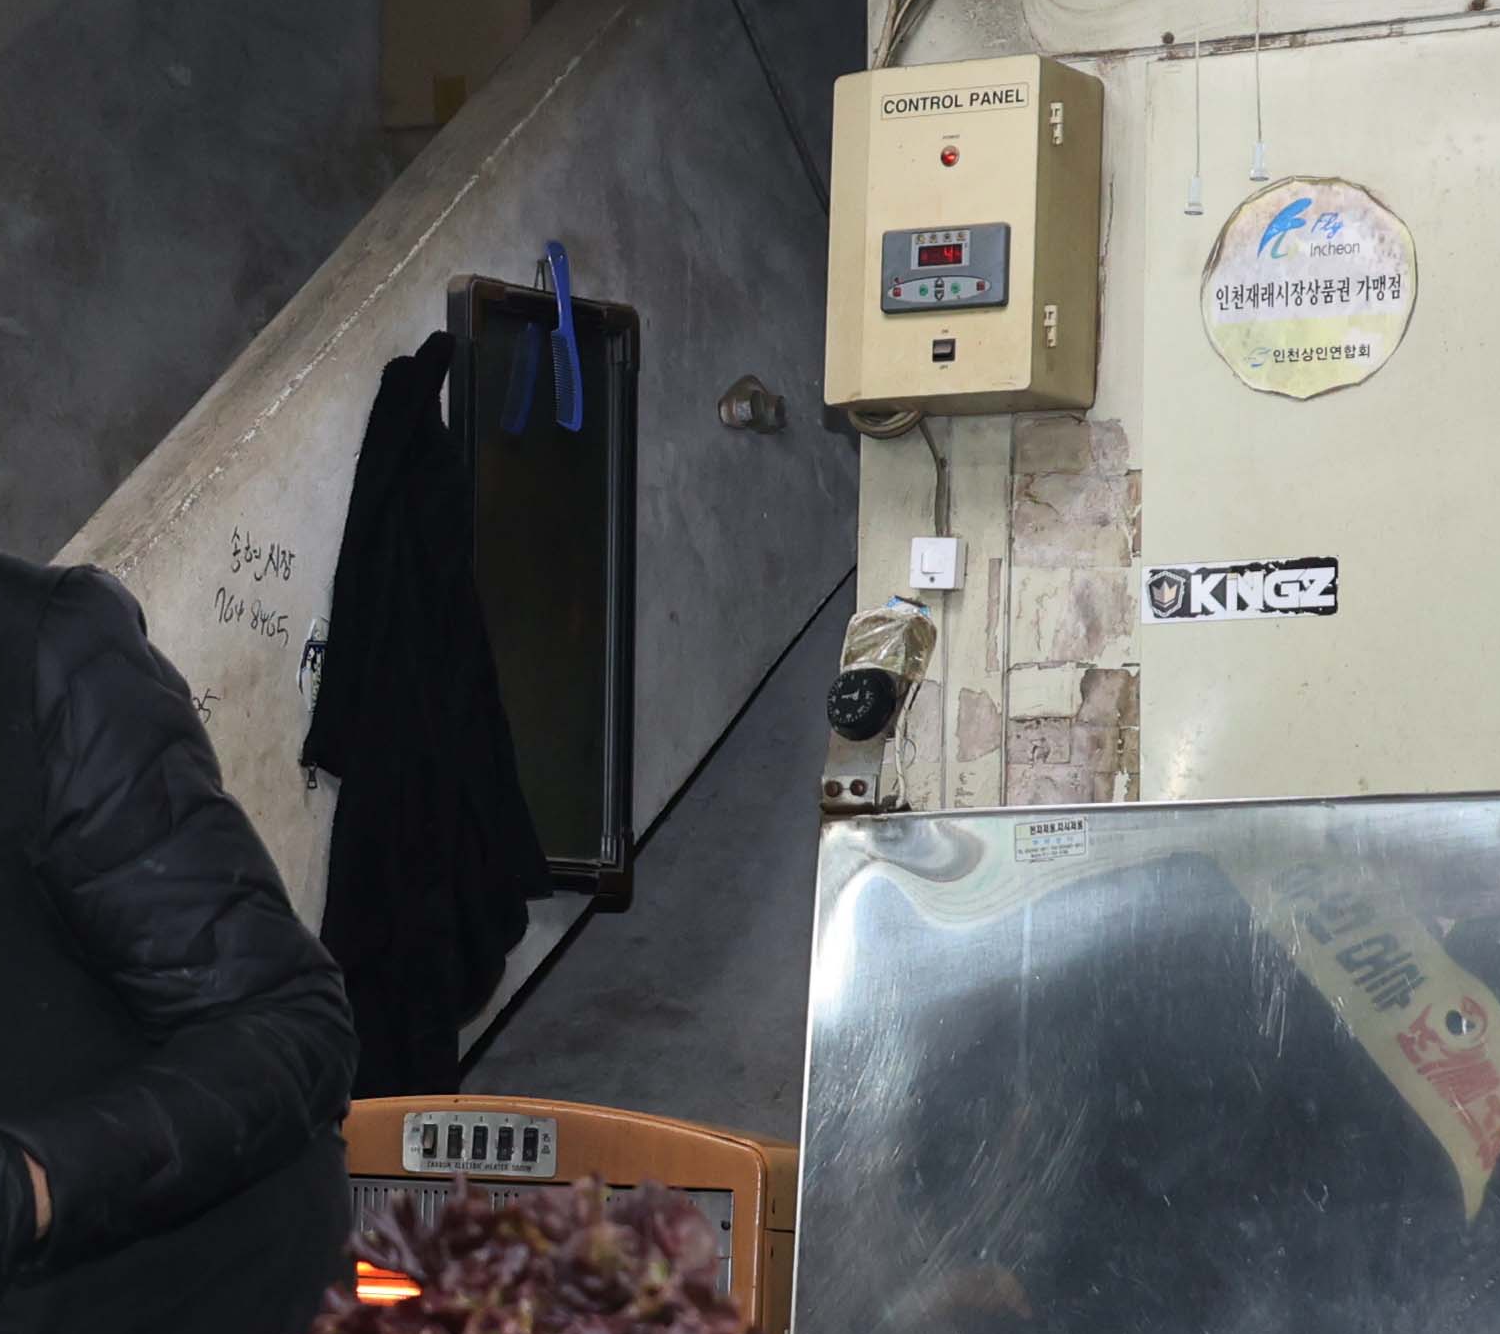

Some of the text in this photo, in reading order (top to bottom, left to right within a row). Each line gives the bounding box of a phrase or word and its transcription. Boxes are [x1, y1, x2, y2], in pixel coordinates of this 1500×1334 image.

[884, 88, 1024, 115] CONTROL PANEL
[1311, 212, 1344, 239] Fly
[1310, 241, 1360, 257] Incheon
[1216, 273, 1401, 311] 인천재래시장상품권 가맹점
[1273, 344, 1370, 363] 인천상인연합회
[1189, 565, 1337, 616] KINGZ
